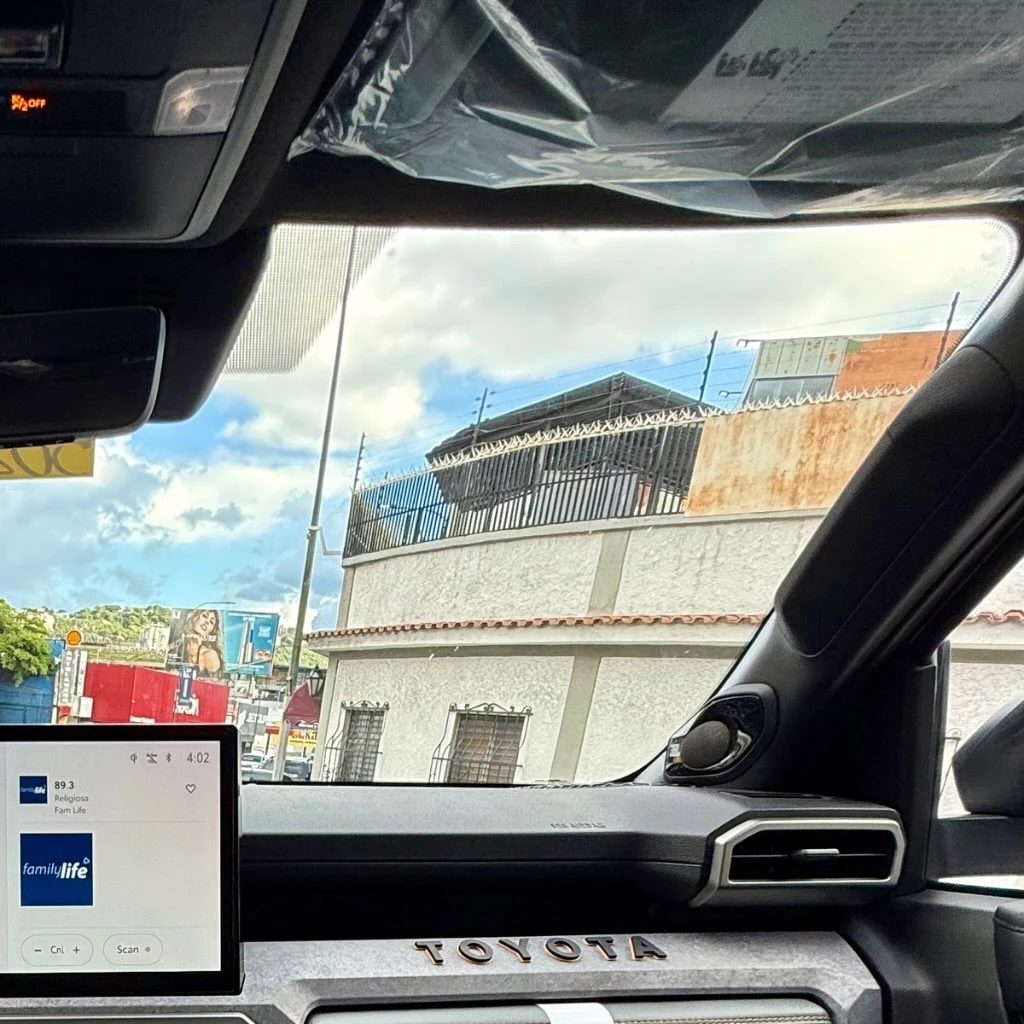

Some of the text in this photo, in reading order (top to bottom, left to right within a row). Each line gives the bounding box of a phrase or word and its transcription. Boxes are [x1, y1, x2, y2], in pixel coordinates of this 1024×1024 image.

[187, 752, 210, 764] 4:02
[54, 781, 75, 790] 89.3
[54, 806, 87, 814] Fam Life
[116, 945, 139, 954] Scan
[414, 935, 668, 966] TOYOTA
